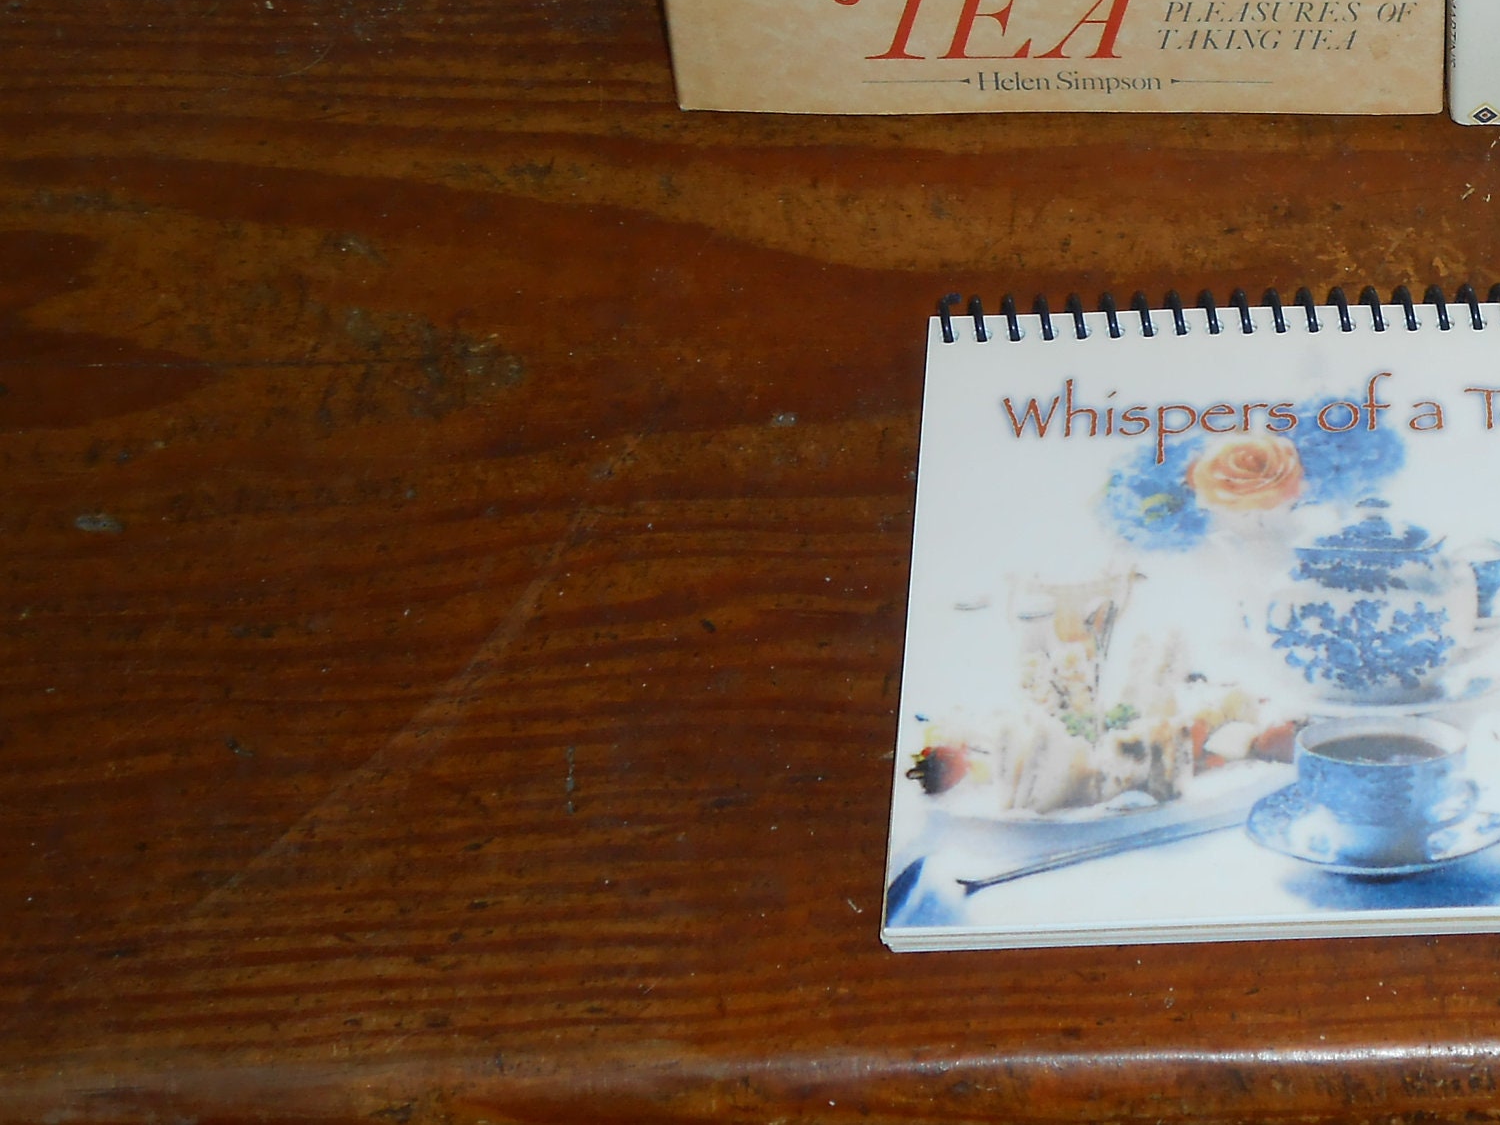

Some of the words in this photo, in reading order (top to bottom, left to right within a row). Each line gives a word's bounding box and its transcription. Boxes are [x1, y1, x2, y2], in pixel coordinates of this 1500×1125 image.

[1163, 1, 1361, 23] PLEASURES
[1376, 1, 1418, 24] OF
[1158, 29, 1282, 51] TAKING
[1293, 29, 1359, 51] TEA
[978, 71, 1050, 92] Helen
[1056, 70, 1161, 94] Simpson
[1003, 378, 1297, 465] Whispers
[1316, 372, 1393, 434] of
[1408, 403, 1444, 431] a
